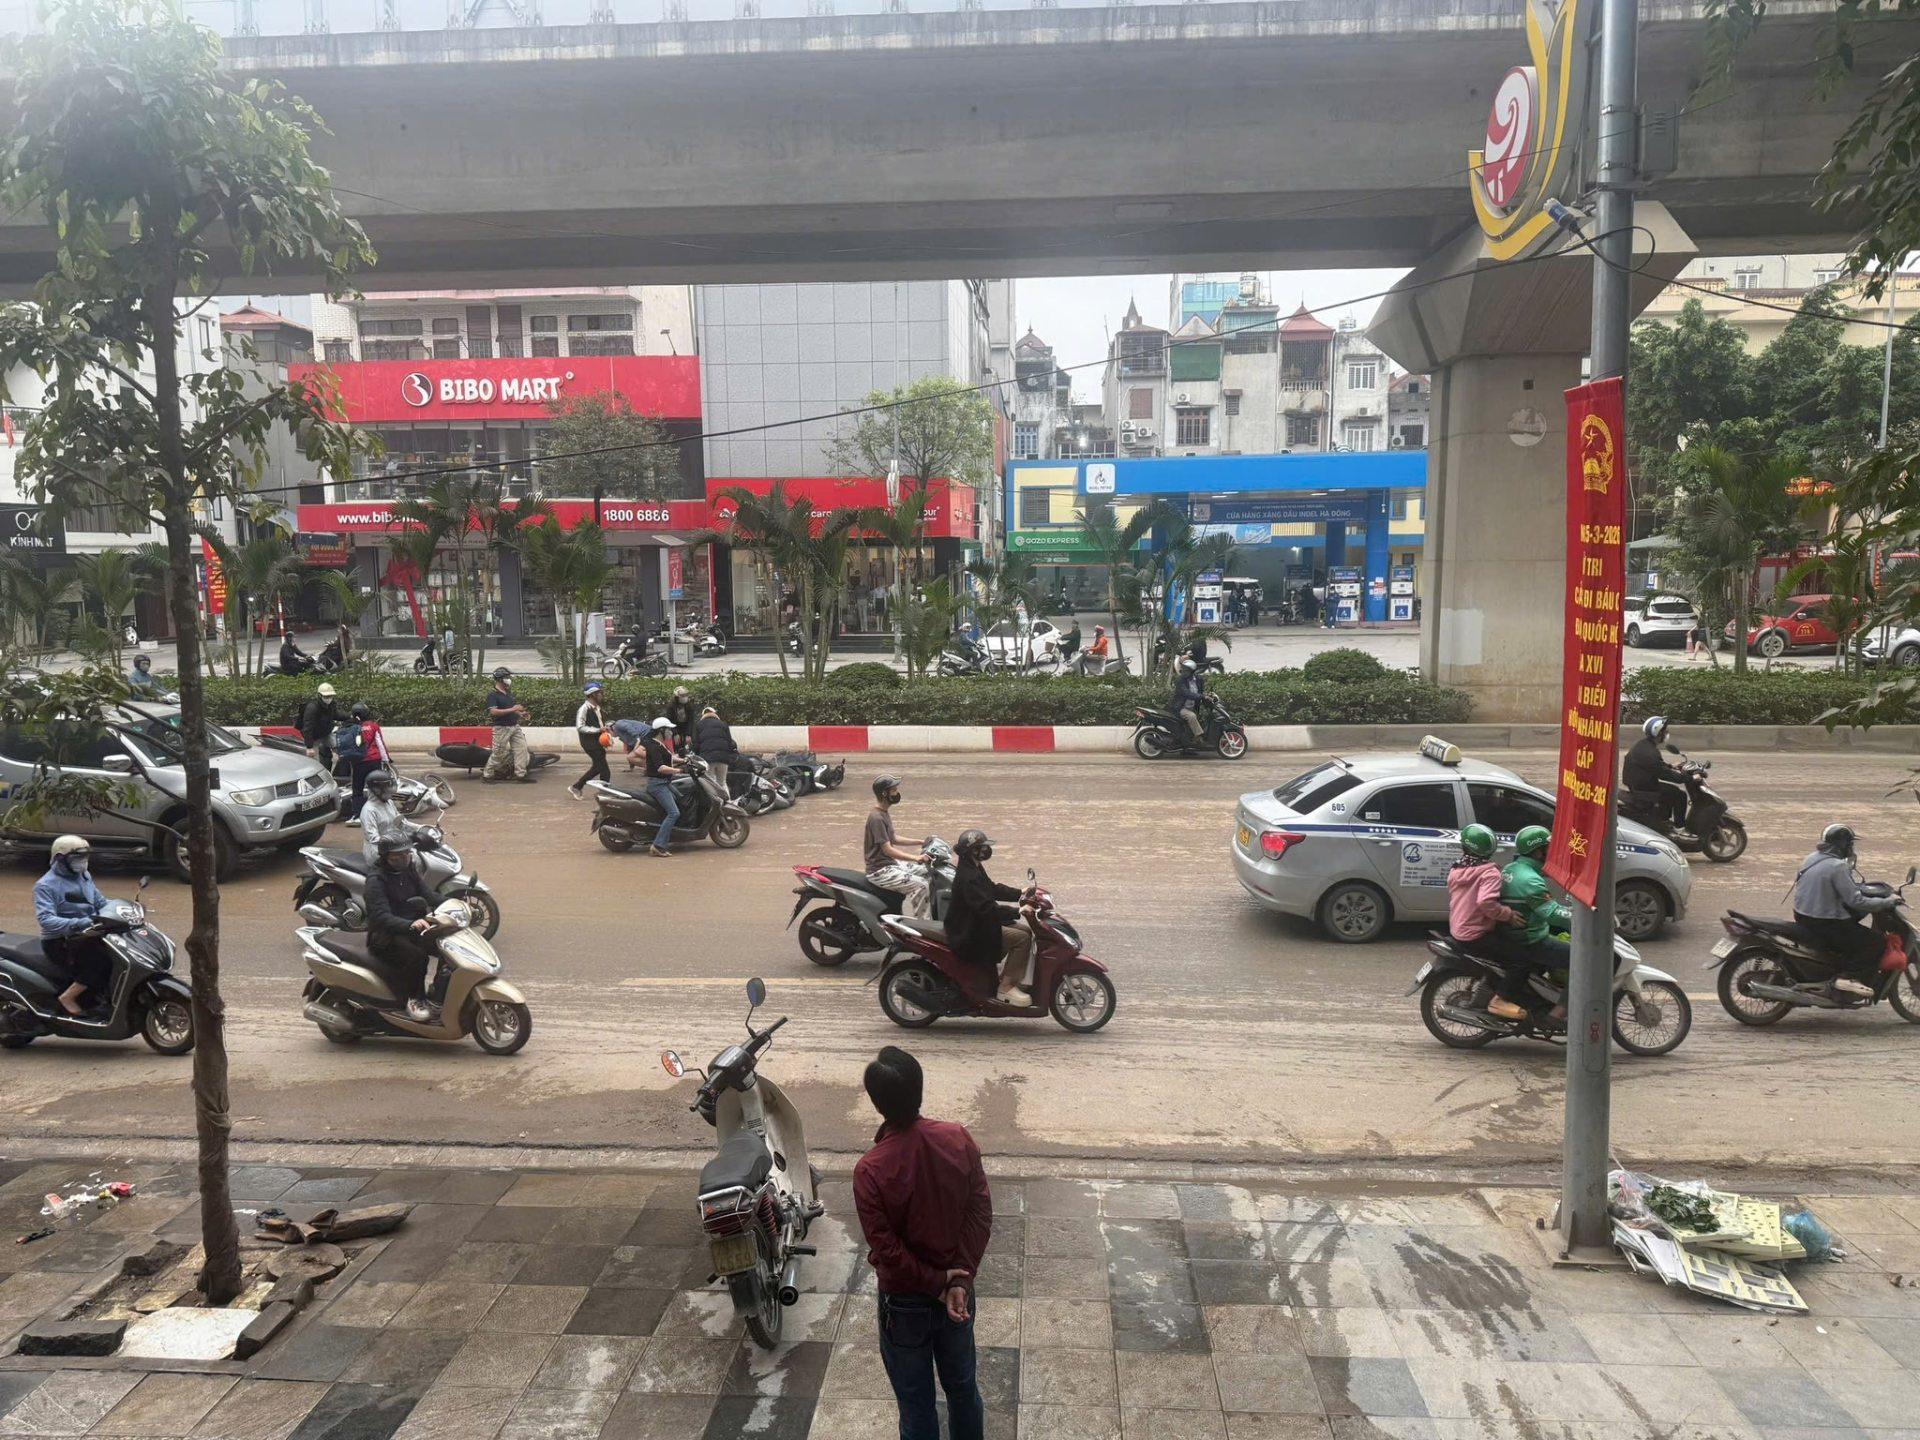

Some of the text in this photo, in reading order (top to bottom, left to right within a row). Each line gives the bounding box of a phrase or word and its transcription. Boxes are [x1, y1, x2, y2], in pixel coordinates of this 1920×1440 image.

[439, 376, 561, 402] BIBO MART
[603, 509, 670, 522] 1800 6886
[10, 533, 34, 547] KÍNH
[1582, 616, 1608, 643] QUỐC
[1586, 653, 1604, 675] XVI
[1583, 681, 1607, 707] BIỂU
[1576, 744, 1594, 769] CẤP
[1331, 803, 1346, 811] 605
[1526, 837, 1543, 847] Grab
